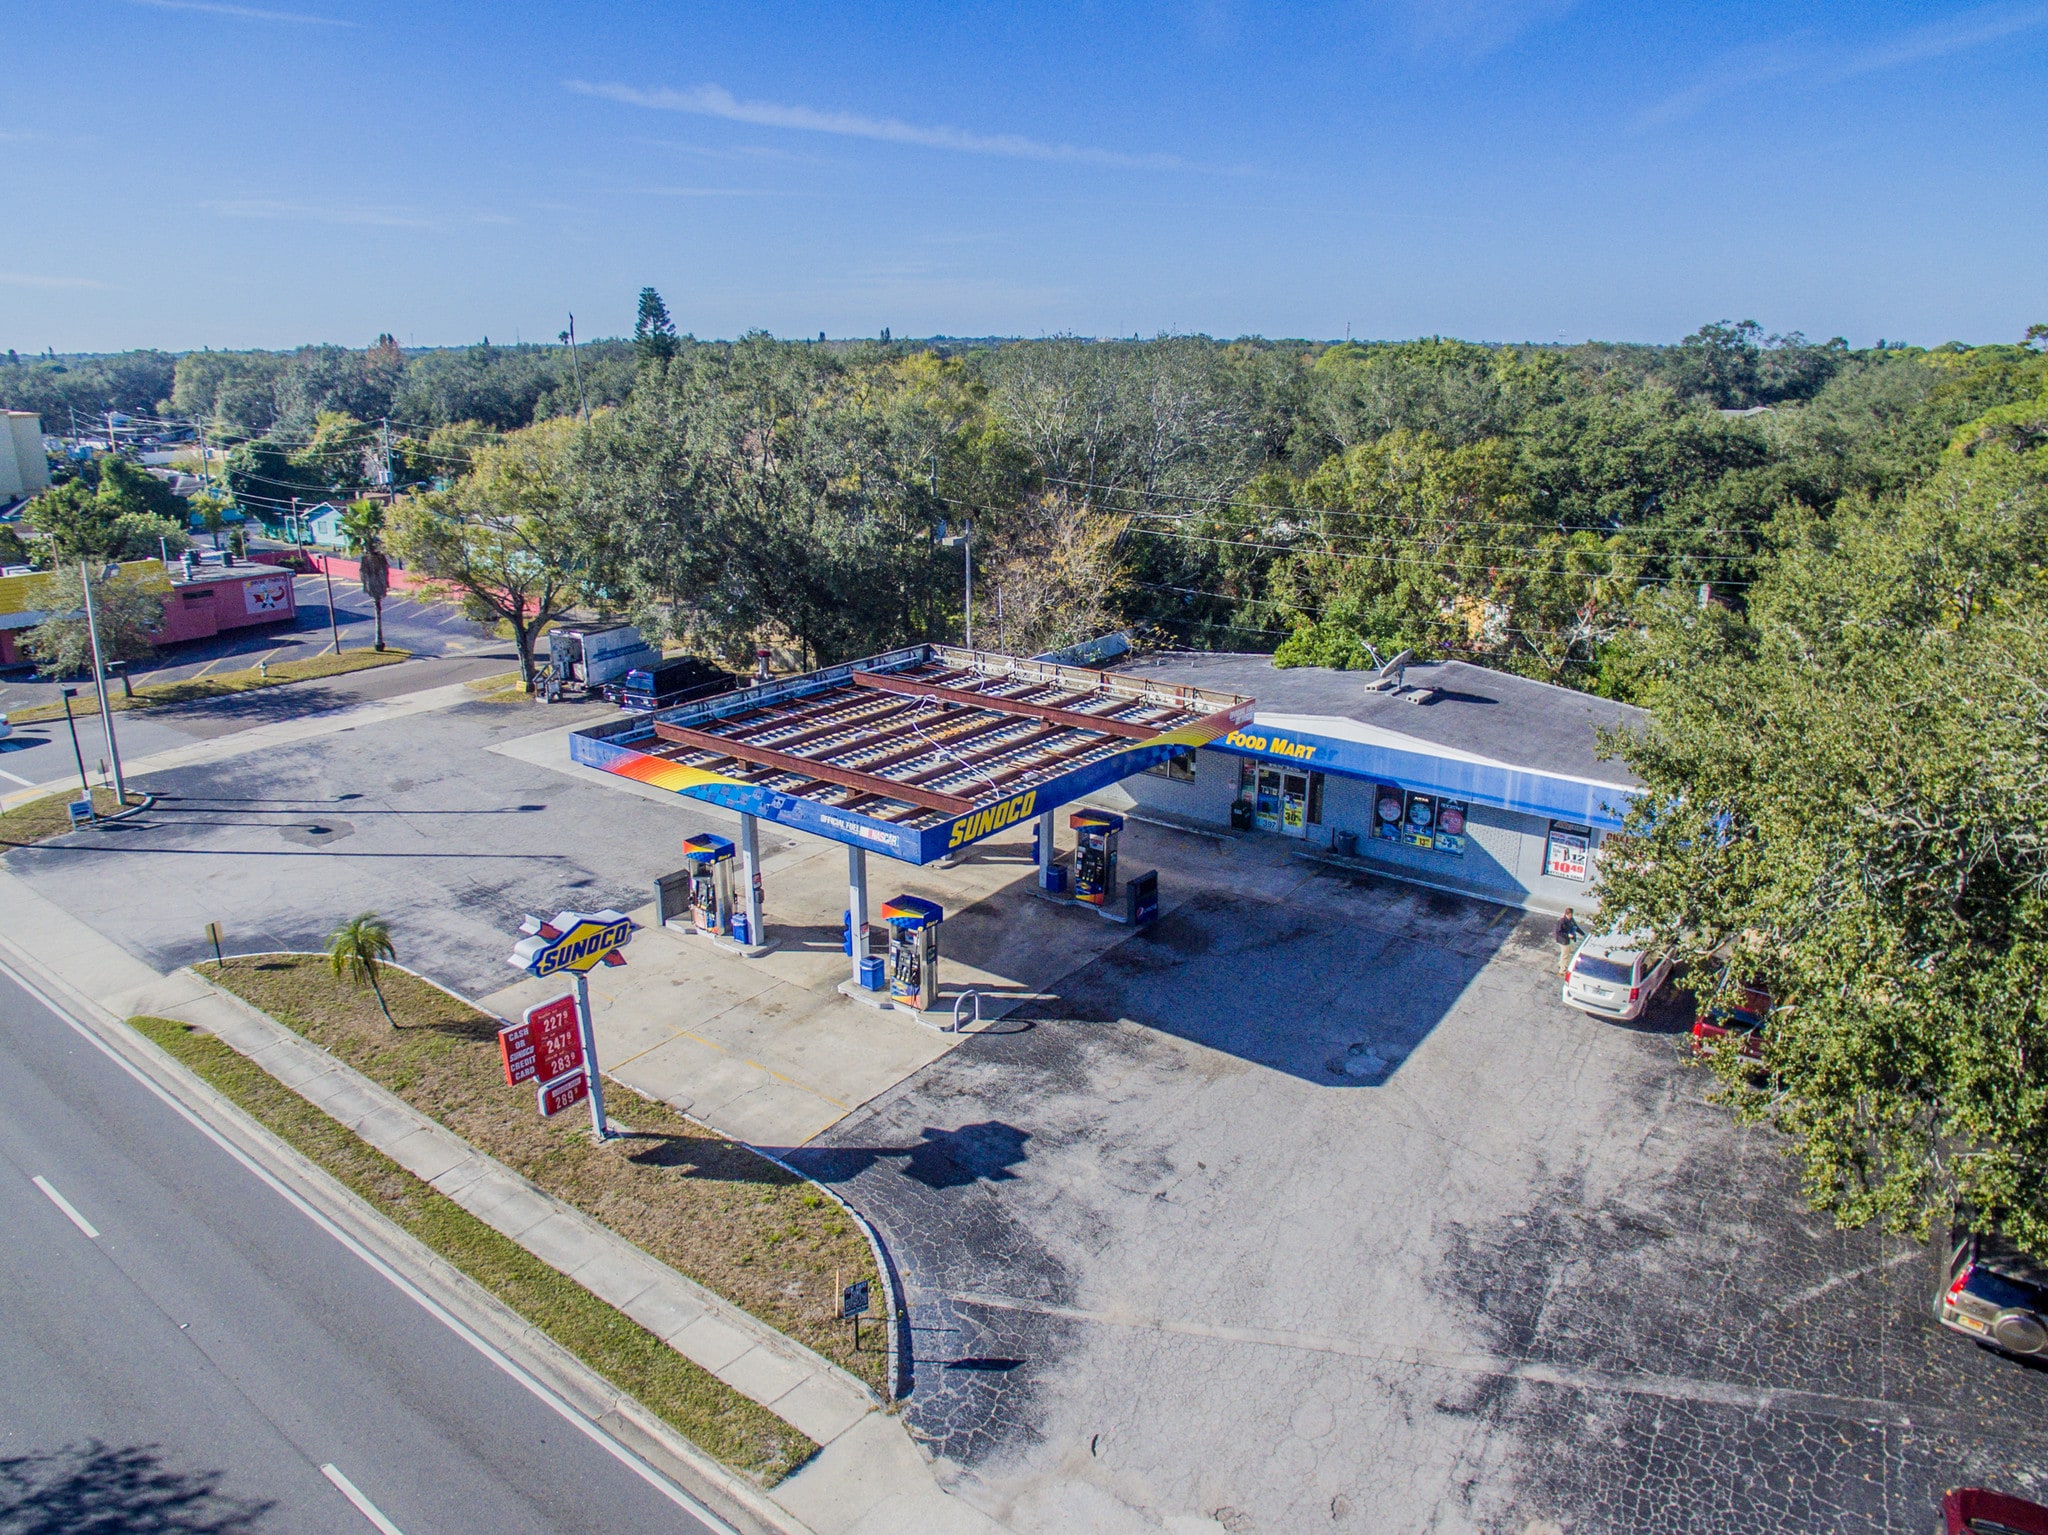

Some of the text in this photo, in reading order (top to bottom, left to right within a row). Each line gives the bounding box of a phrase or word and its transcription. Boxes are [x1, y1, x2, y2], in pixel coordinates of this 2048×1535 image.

[1225, 730, 1317, 760] FOOD MART
[948, 790, 1037, 849] SUNOCO
[820, 814, 899, 847] OFFICIAL FUEL NASCAR
[542, 922, 628, 972] SUNOCO
[509, 1027, 529, 1042] CASH
[509, 1045, 535, 1063] SUNOCO
[515, 1039, 526, 1050] OR
[510, 1054, 536, 1073] CREDIT
[515, 1065, 536, 1081] CARD
